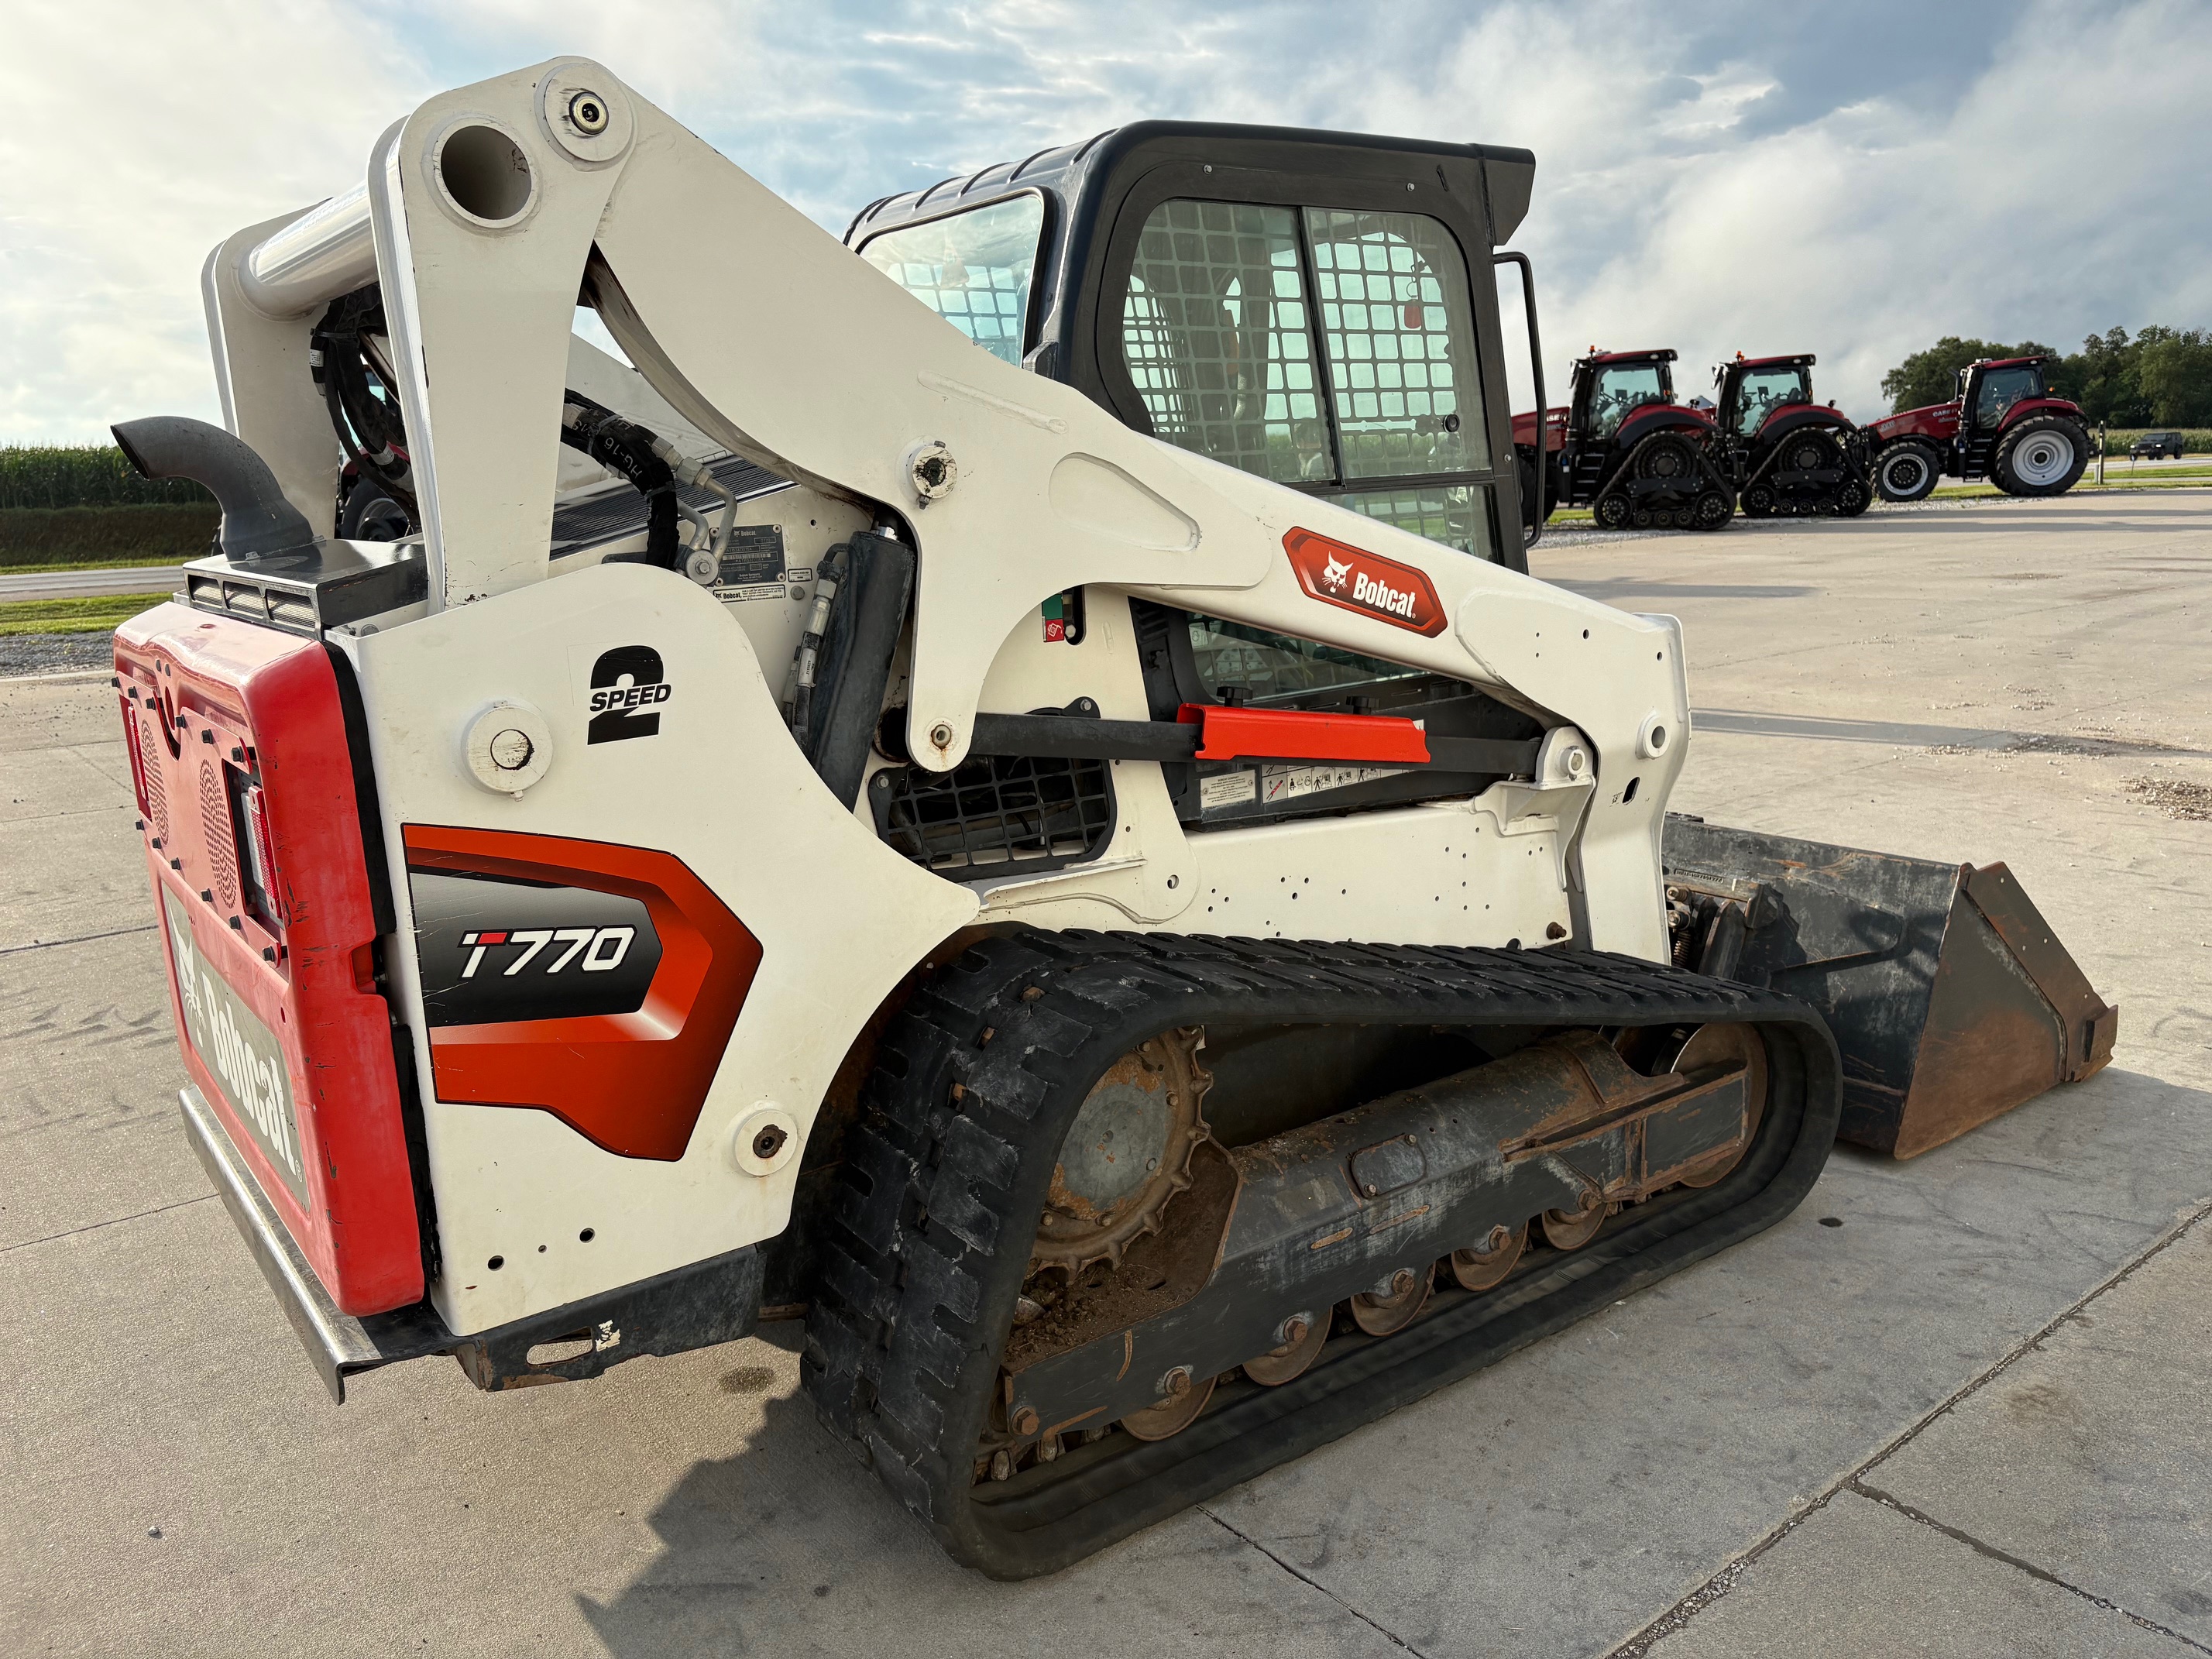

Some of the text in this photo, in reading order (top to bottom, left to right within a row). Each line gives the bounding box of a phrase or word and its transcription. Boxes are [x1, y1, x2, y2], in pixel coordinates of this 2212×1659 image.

[604, 437, 642, 479] HG-16
[1353, 572, 1415, 618] Bobcat
[587, 645, 664, 745] 2
[589, 684, 672, 712] SPEED
[460, 926, 636, 979] T770
[201, 971, 297, 1176] Bobcat
